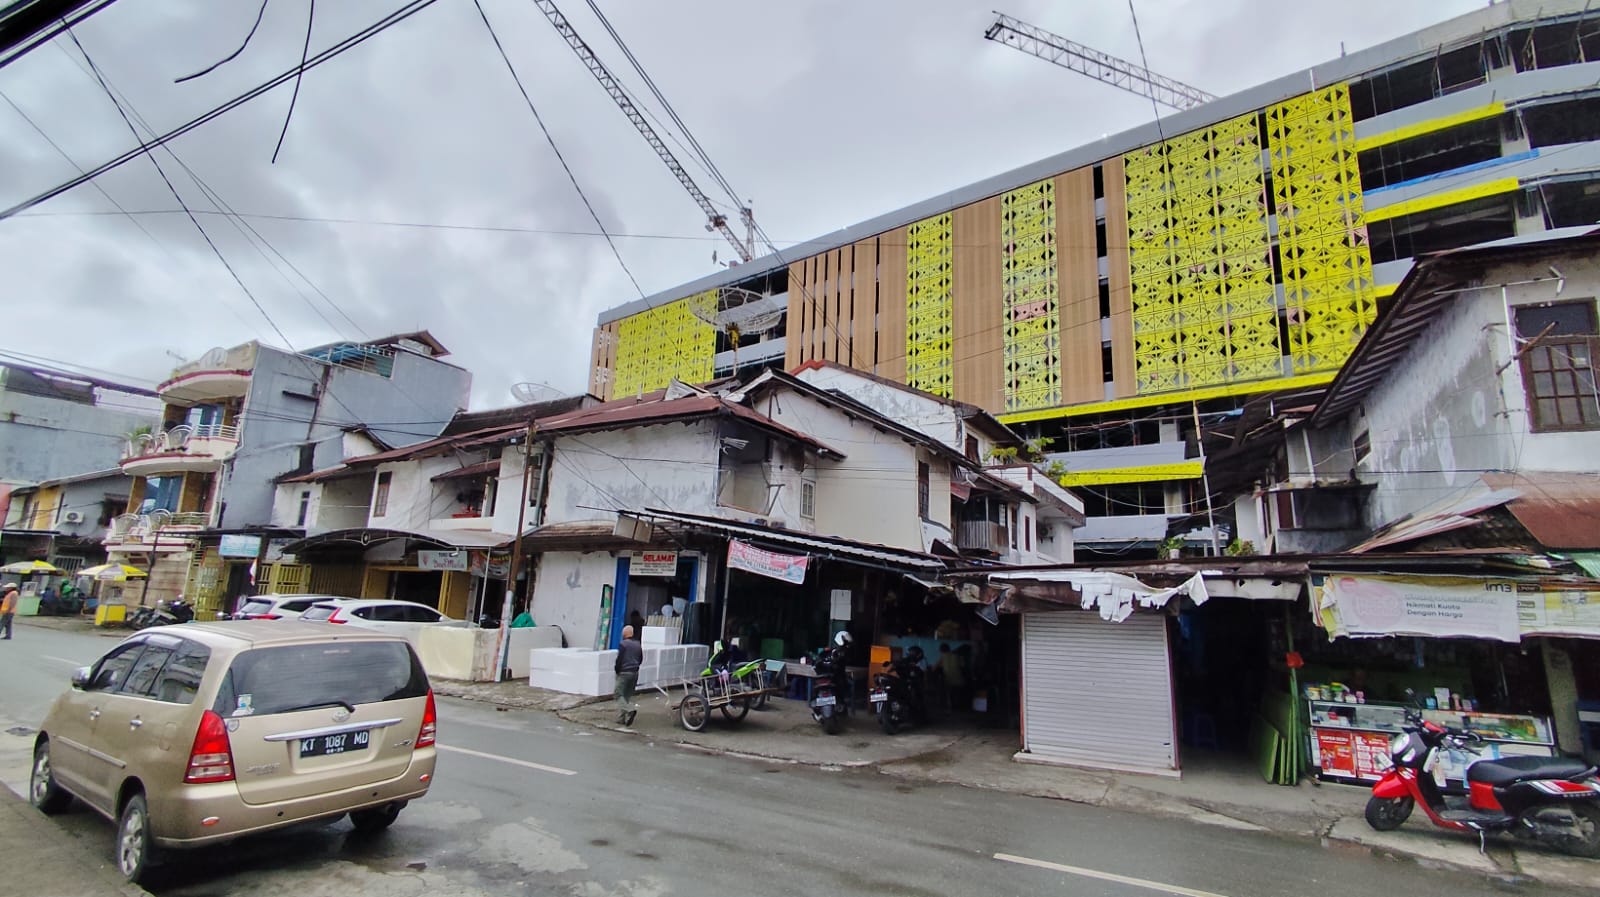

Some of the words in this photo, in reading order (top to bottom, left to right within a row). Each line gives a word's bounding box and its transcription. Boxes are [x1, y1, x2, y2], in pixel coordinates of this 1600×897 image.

[643, 554, 675, 562] SELAMAT
[302, 739, 315, 751] KT
[325, 734, 347, 748] 1087
[354, 732, 368, 744] MD
